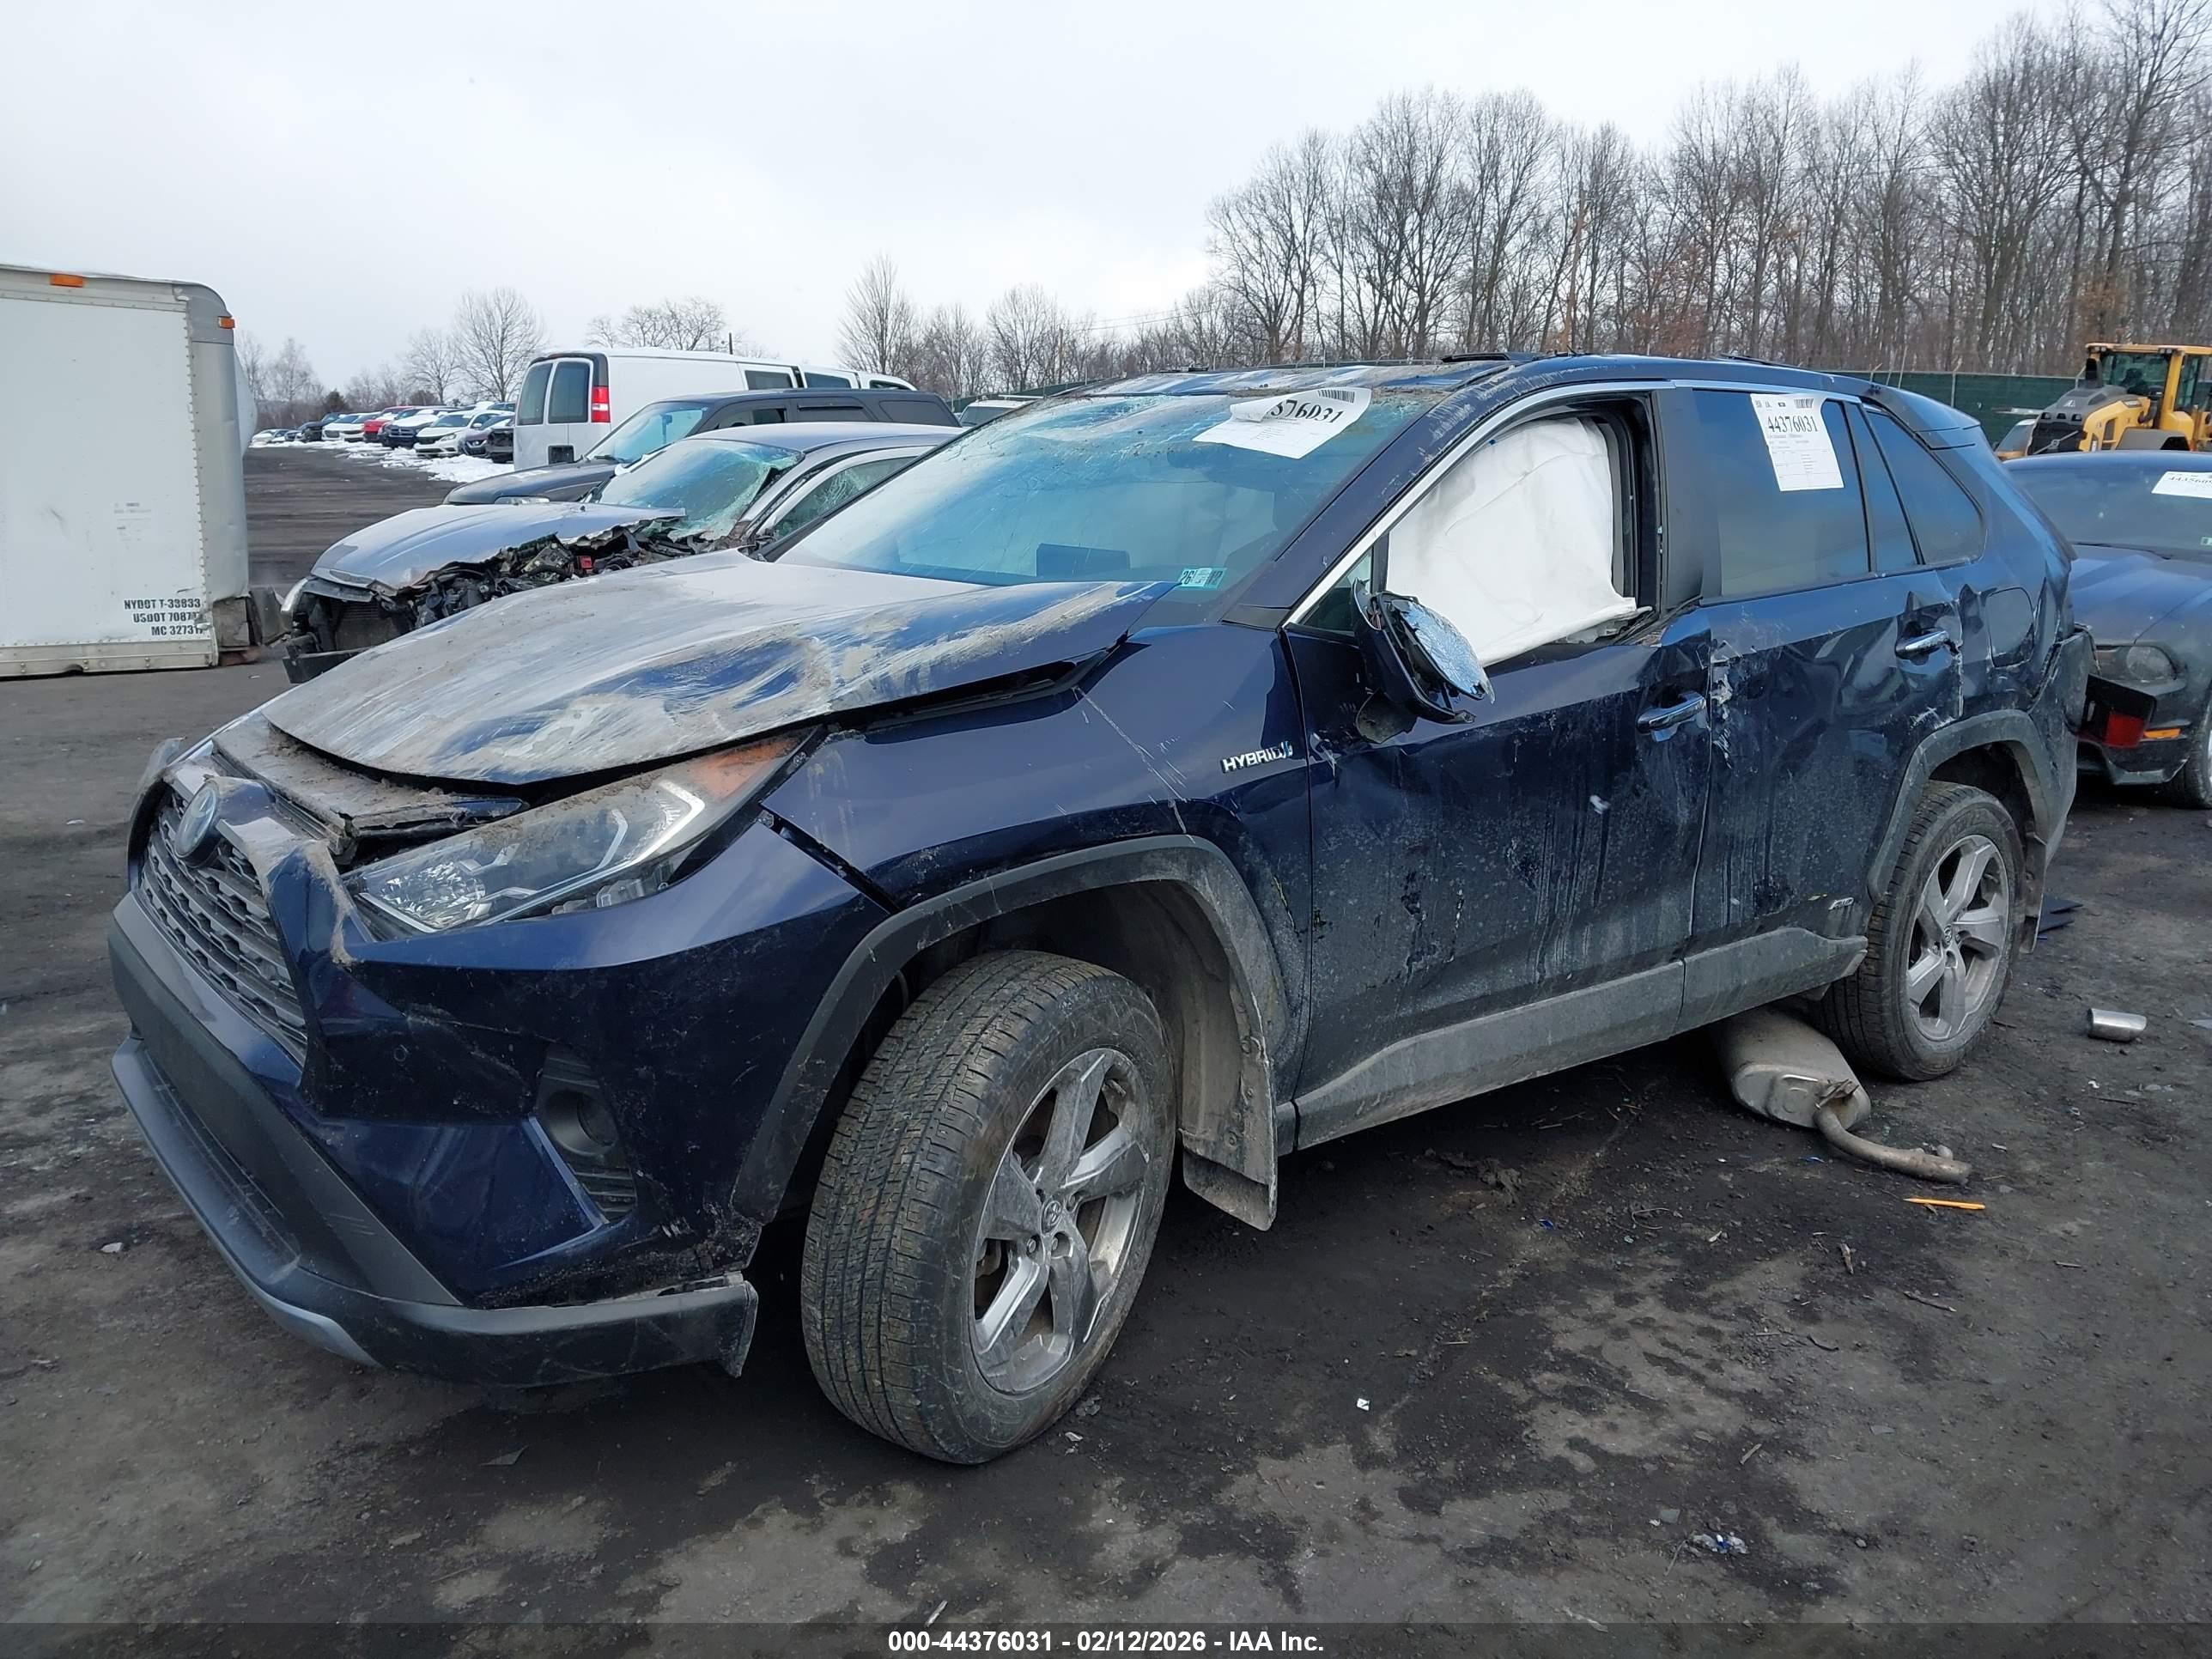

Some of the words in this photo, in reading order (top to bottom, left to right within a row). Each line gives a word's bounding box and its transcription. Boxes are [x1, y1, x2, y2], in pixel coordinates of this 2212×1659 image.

[1266, 398, 1345, 423] 376031
[1767, 416, 1818, 433] 44376031
[124, 599, 156, 610] NYDOT
[133, 612, 166, 623] USDOT
[151, 626, 167, 635] MC
[1222, 745, 1285, 772] HYBRID
